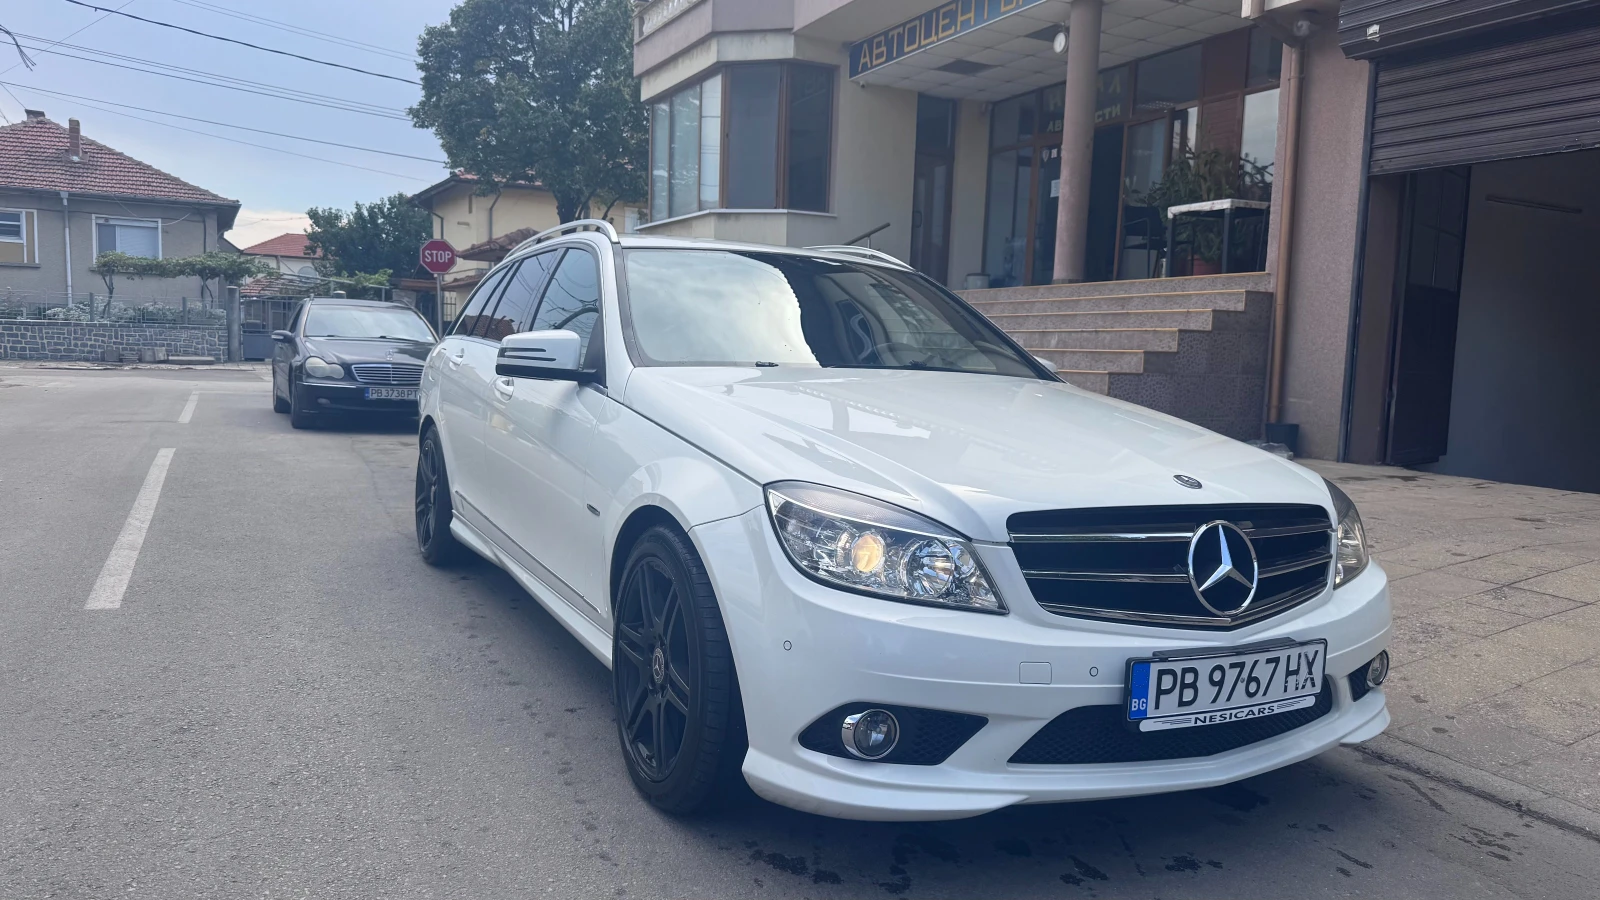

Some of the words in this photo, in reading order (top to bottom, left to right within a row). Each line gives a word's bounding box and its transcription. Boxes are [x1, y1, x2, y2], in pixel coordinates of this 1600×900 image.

[425, 250, 452, 262] STOP
[371, 389, 382, 397] PB
[384, 389, 405, 397] 3738
[407, 390, 418, 398] PT
[1154, 667, 1199, 710] PB
[1208, 656, 1281, 704] 9767
[1283, 649, 1319, 693] HX
[1131, 699, 1147, 711] BG
[1194, 705, 1275, 725] NESICARS
